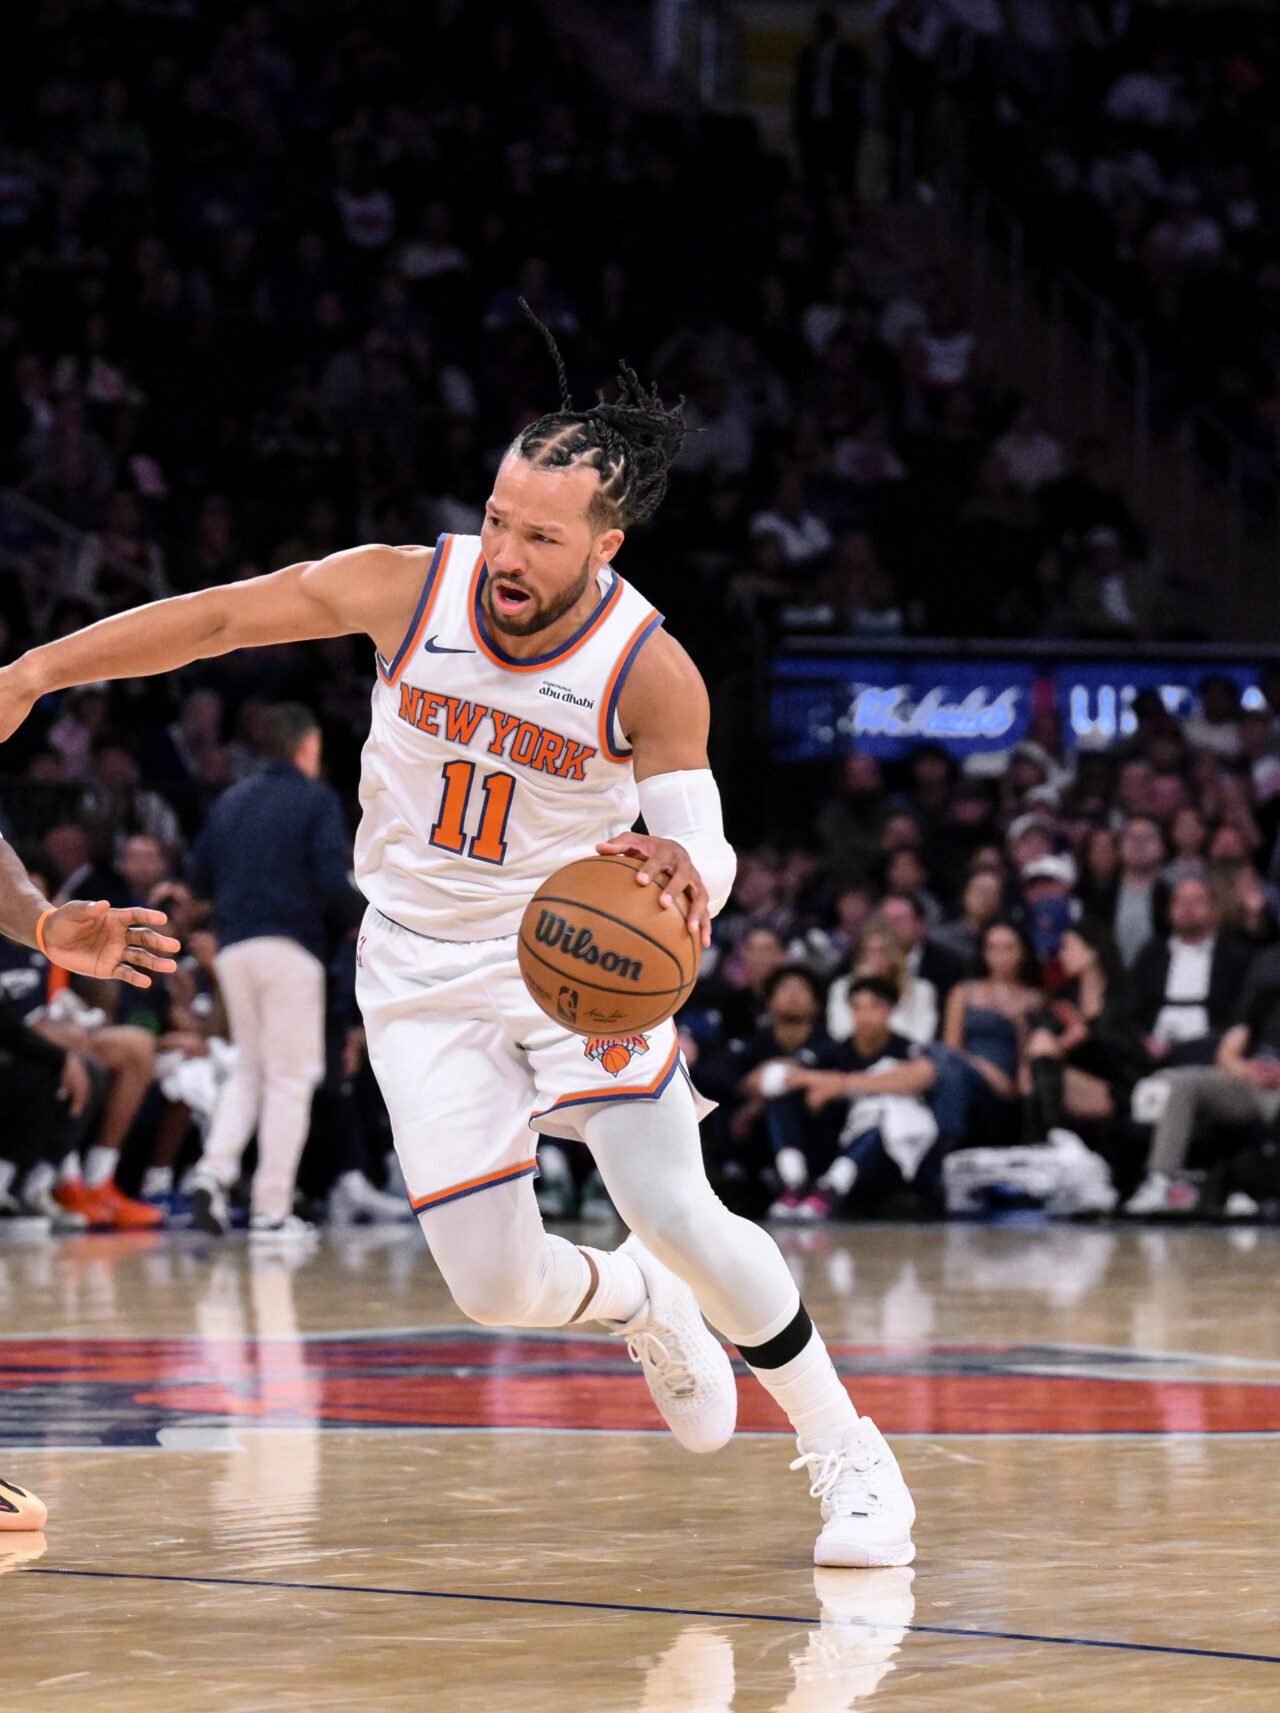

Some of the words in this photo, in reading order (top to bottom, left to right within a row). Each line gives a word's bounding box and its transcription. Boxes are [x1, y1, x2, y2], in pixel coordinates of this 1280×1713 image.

[398, 682, 487, 745] NEW
[487, 709, 599, 782] YORK
[538, 686, 561, 699] abu
[561, 693, 595, 710] dhabi
[428, 759, 517, 866] 11
[534, 908, 645, 982] Wilson
